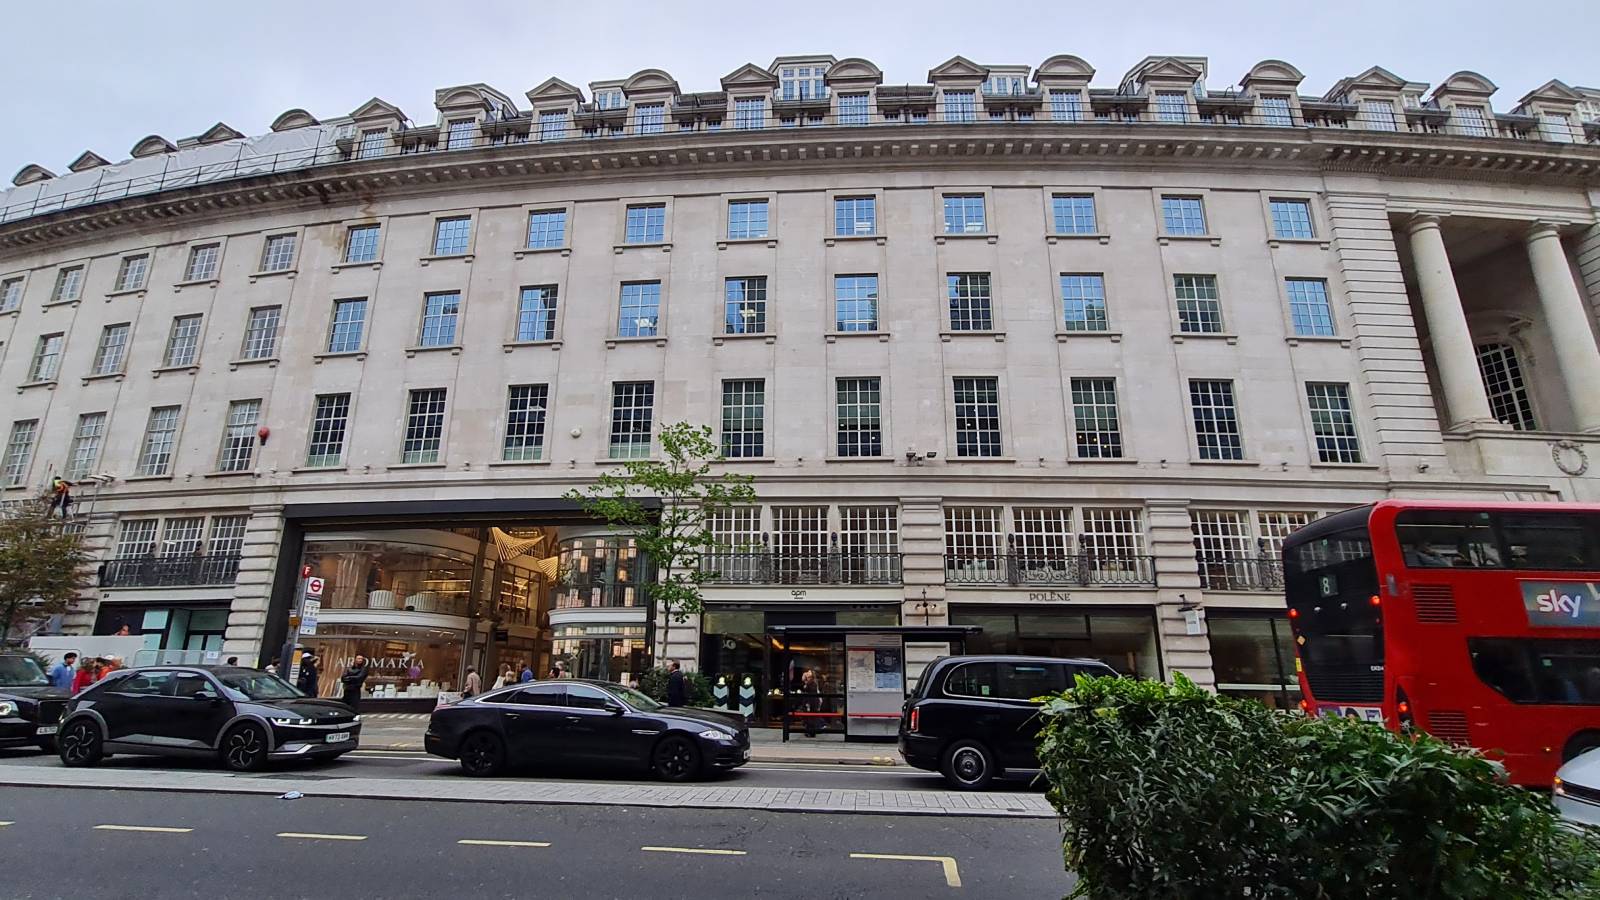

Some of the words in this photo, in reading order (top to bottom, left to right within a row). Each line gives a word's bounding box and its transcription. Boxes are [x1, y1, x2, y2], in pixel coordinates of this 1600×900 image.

[304, 566, 311, 575] F
[1322, 577, 1330, 594] 8
[1536, 589, 1581, 618] sky
